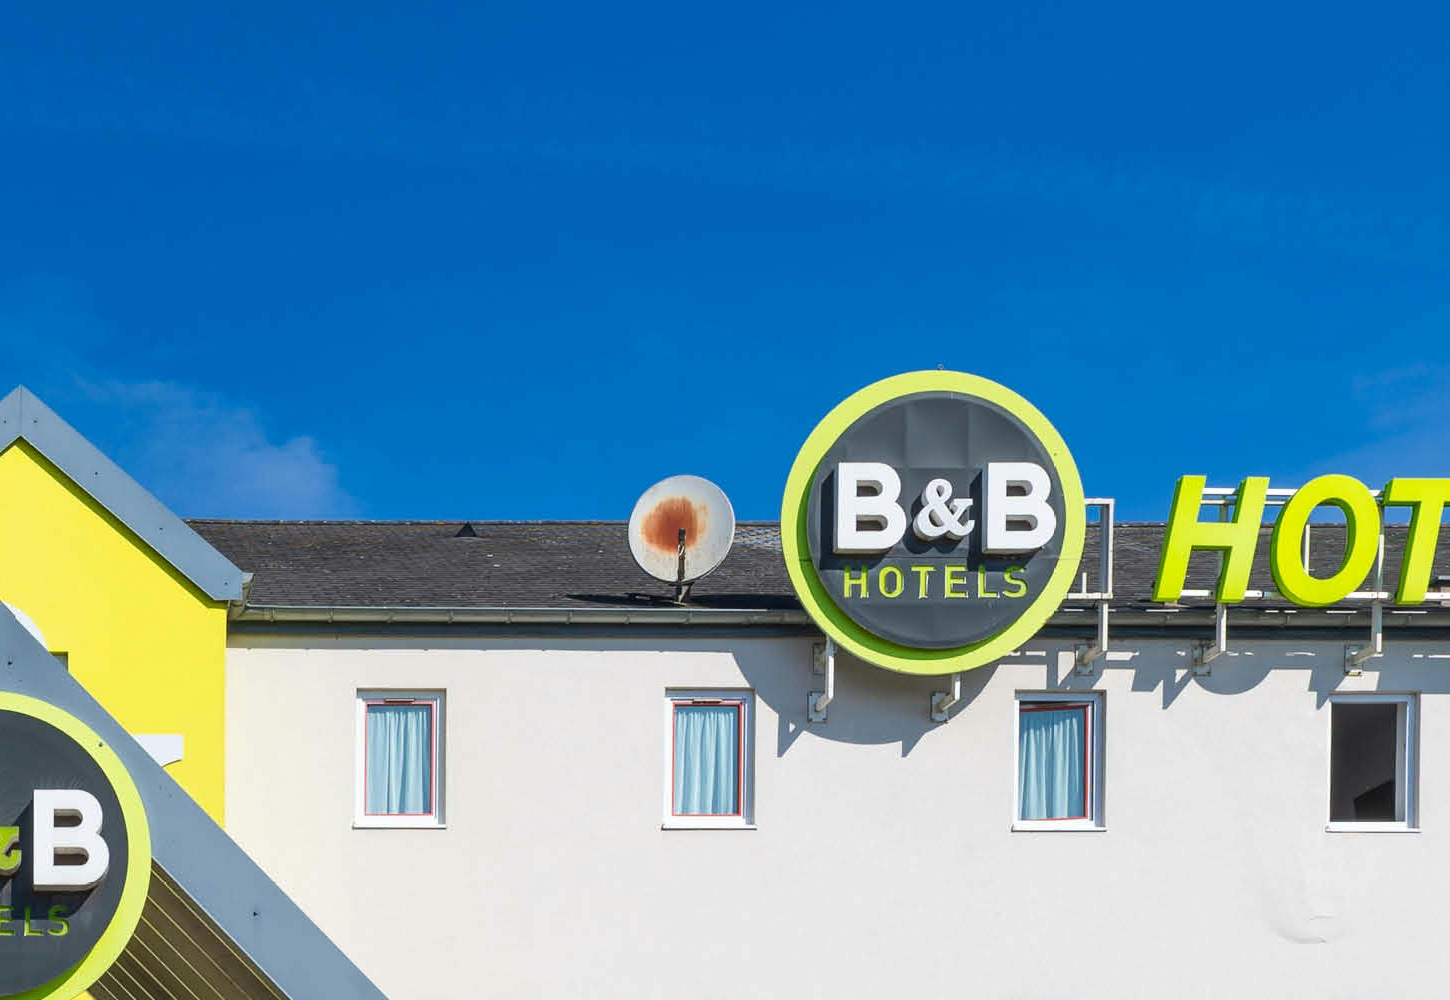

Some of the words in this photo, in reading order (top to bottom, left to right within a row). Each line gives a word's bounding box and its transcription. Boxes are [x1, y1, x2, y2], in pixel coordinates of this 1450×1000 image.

[833, 462, 1057, 555] B&B
[1152, 473, 1450, 608] HOT
[843, 563, 1029, 599] HOTELS
